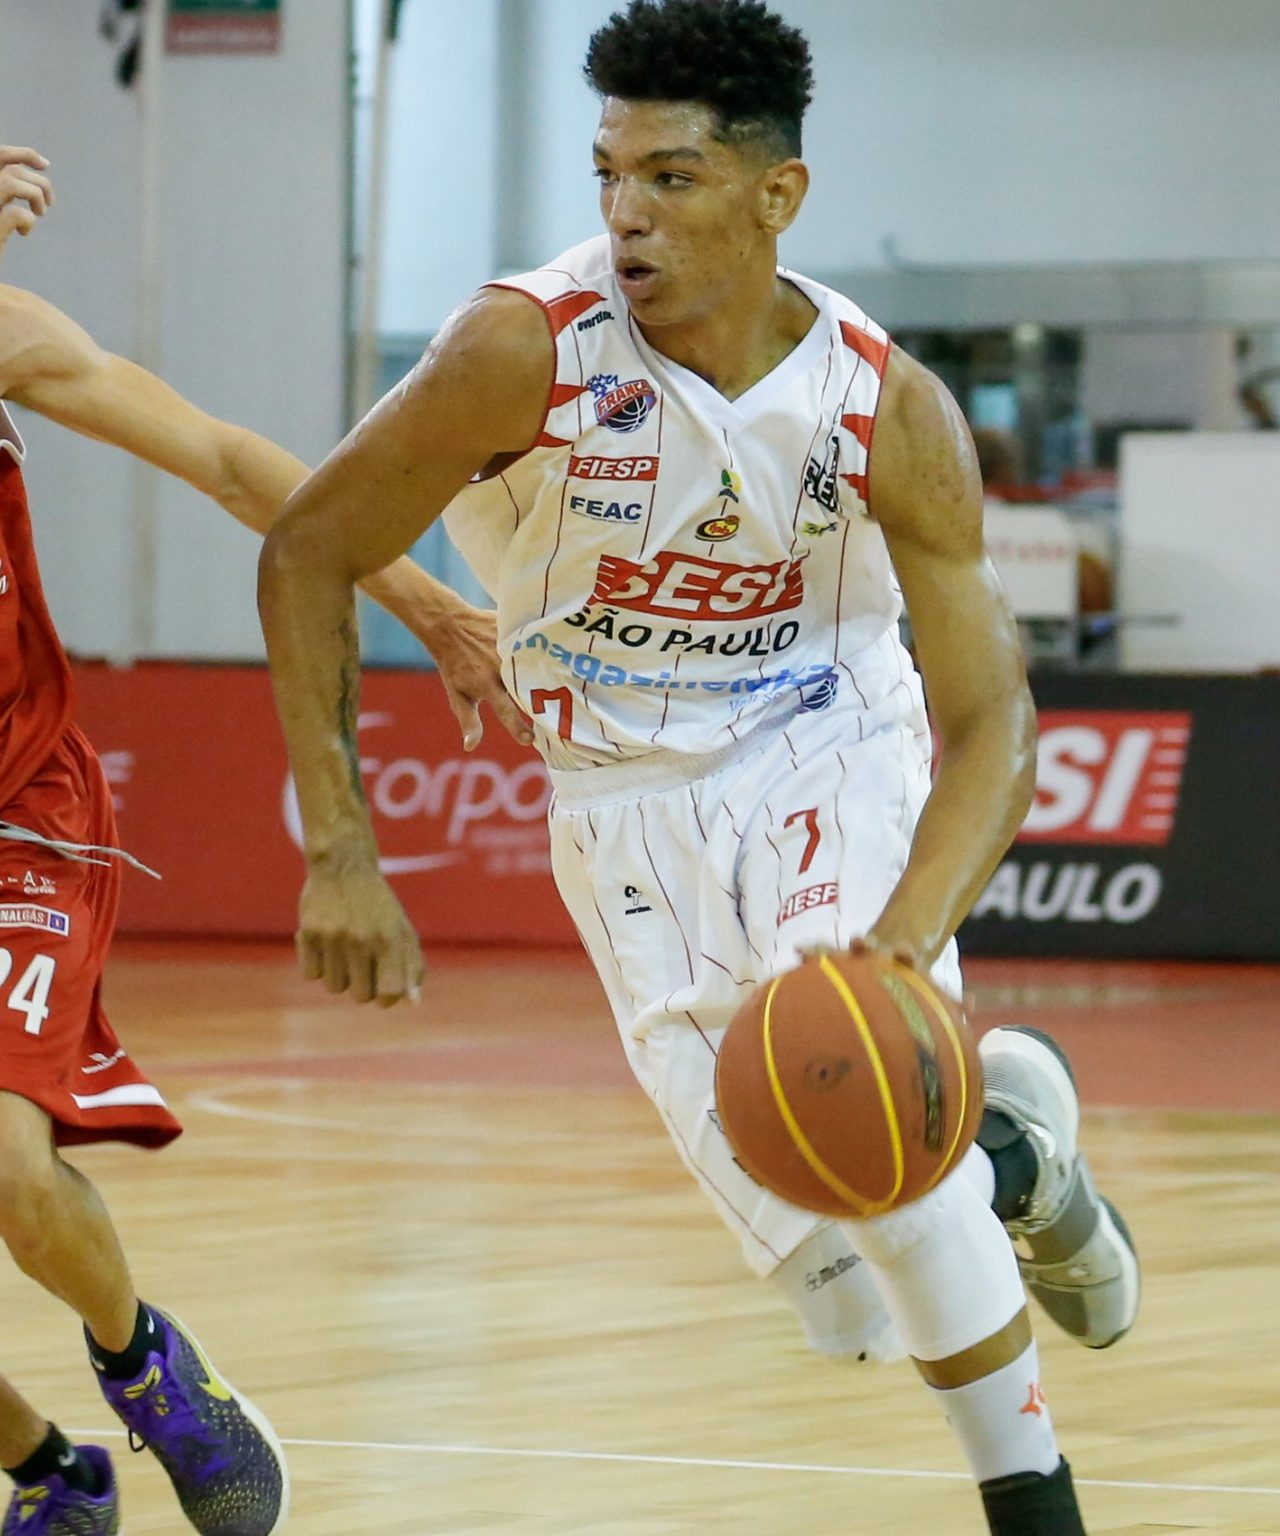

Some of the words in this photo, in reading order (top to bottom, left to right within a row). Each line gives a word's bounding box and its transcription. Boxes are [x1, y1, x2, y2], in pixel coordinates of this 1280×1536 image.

[574, 458, 652, 478] FIESP
[570, 495, 642, 520] FEAC
[606, 558, 793, 613] SESI
[563, 607, 653, 648] SÃO
[659, 621, 800, 657] PAULO
[529, 685, 574, 741] 7
[783, 805, 821, 876] 7
[968, 862, 1163, 924] AULO
